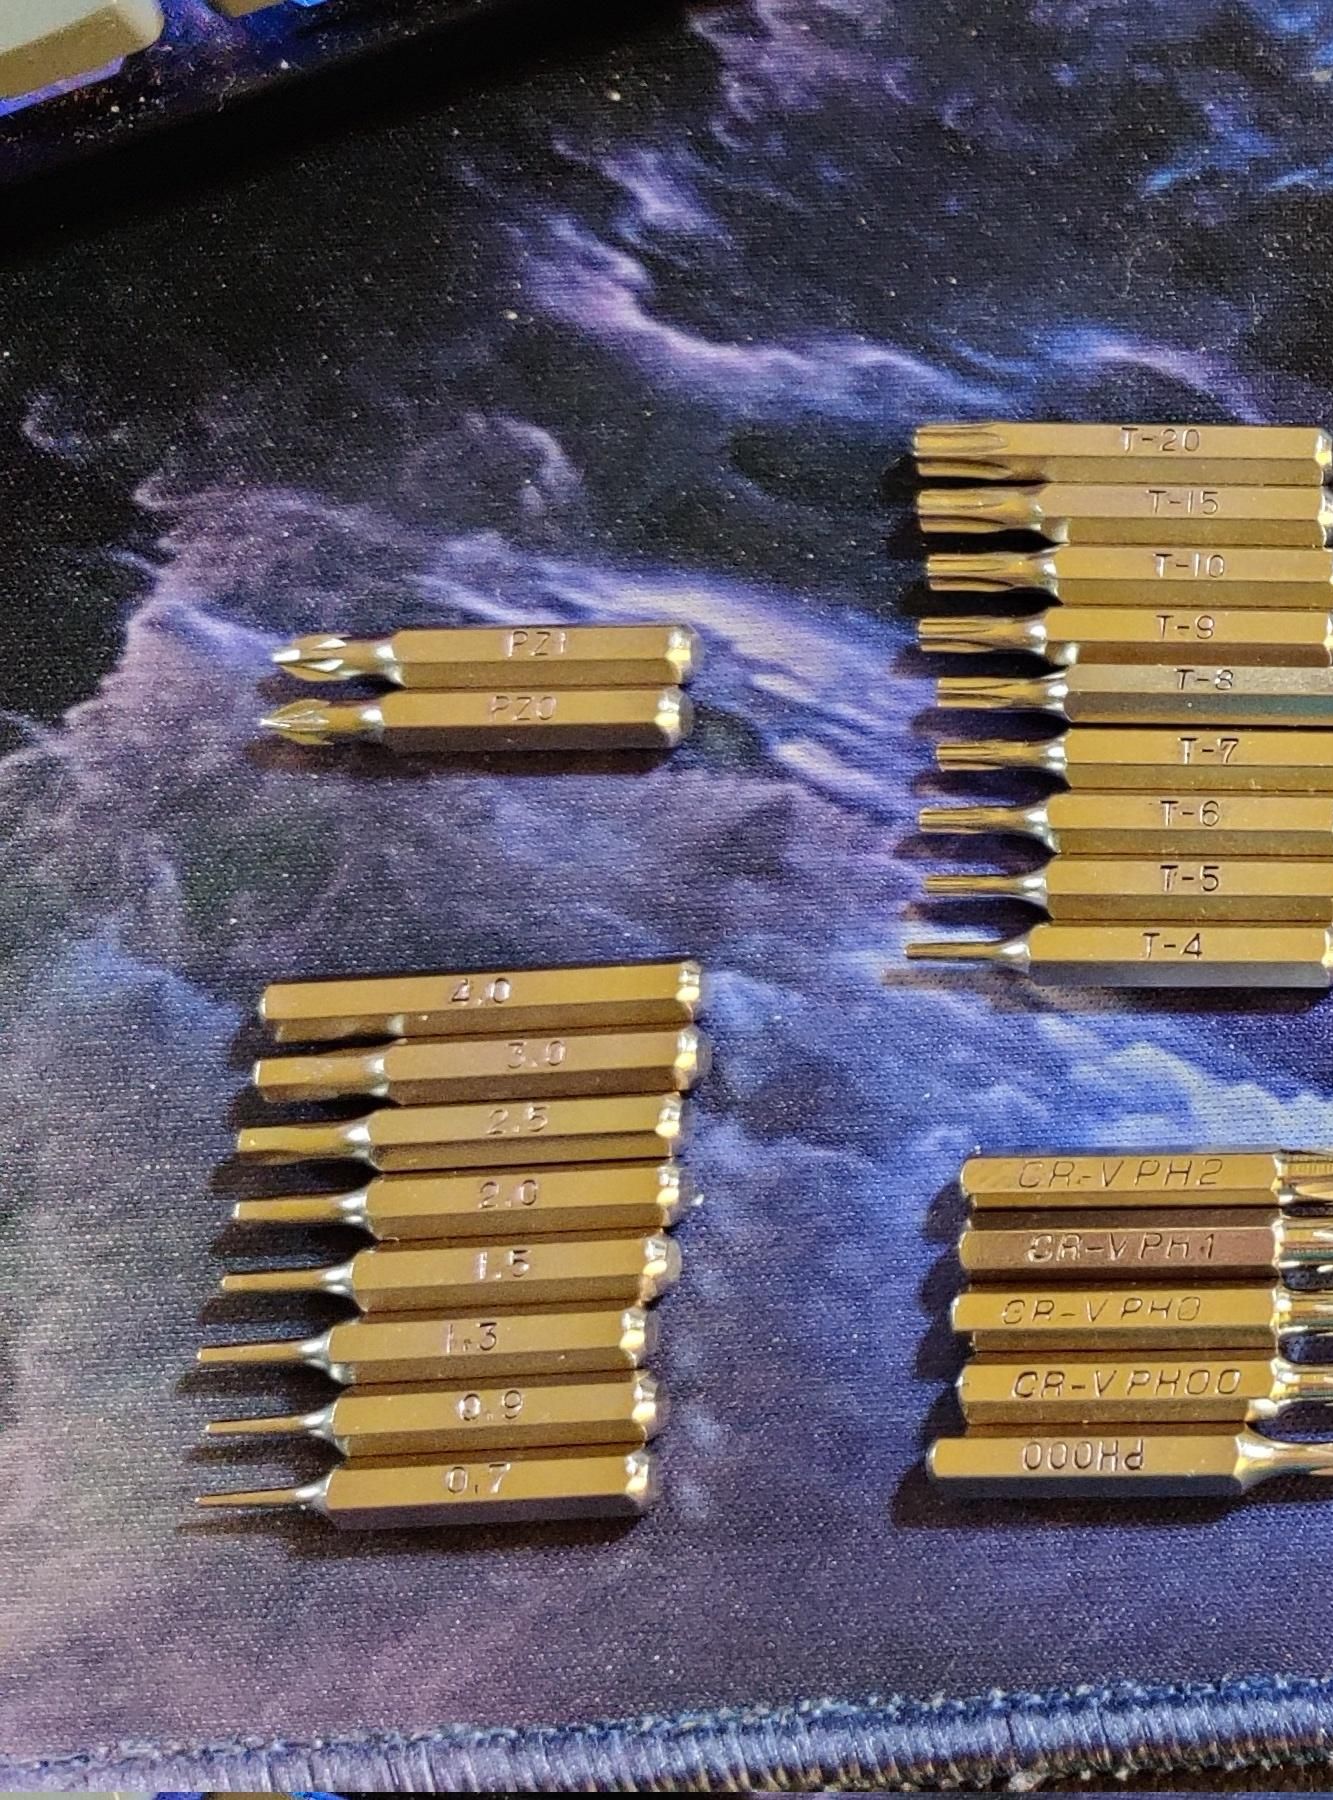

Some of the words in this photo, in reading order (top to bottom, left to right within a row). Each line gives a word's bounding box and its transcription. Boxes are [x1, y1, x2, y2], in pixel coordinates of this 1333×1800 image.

[1121, 427, 1201, 452] T-20
[1148, 489, 1220, 516] T-15
[1153, 553, 1226, 578] T-10
[1155, 615, 1215, 640] T-9
[507, 630, 567, 657] PZ1
[1174, 668, 1234, 691] T-8
[1178, 737, 1239, 764] T-7
[1159, 799, 1221, 827] T-6
[1159, 864, 1220, 892] T-5
[1140, 932, 1203, 960] T-4
[448, 977, 513, 1004] 4.0
[505, 1040, 567, 1069] 3.0
[487, 1104, 549, 1134] 2.5
[1018, 1160, 1124, 1188] CR-V
[1133, 1160, 1224, 1186] PH2
[478, 1178, 539, 1209] 2.0
[1026, 1233, 1126, 1262] CR-V
[1139, 1233, 1214, 1259] PH1
[476, 1249, 530, 1280] 1.5
[1002, 1298, 1110, 1325] CR-V
[445, 1322, 497, 1354] 1.3
[1013, 1369, 1118, 1398] CR-V
[458, 1388, 523, 1422] 0.9
[446, 1462, 511, 1495] 0.7
